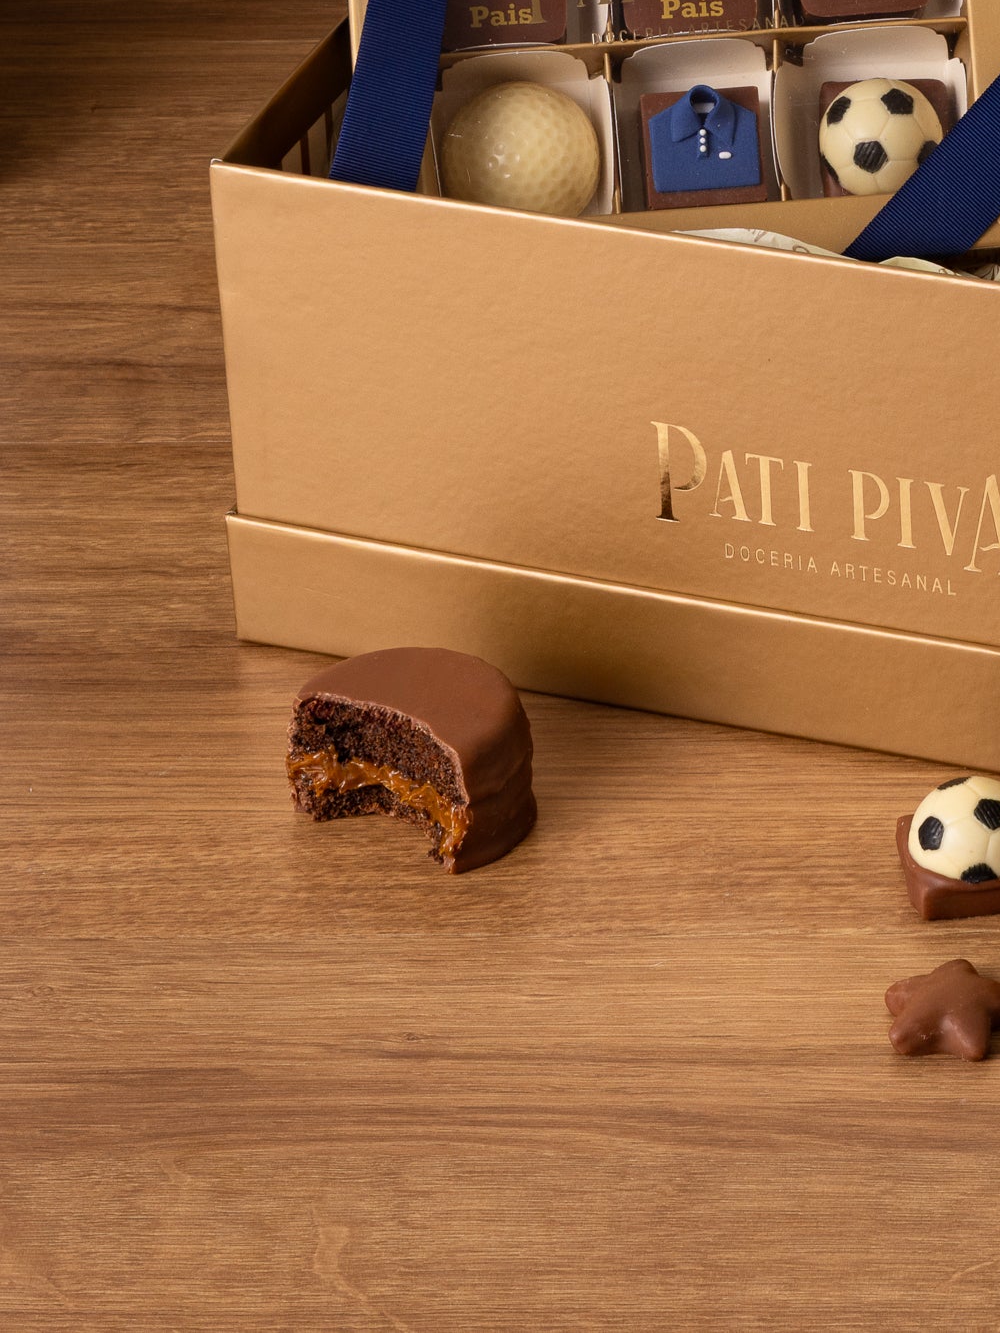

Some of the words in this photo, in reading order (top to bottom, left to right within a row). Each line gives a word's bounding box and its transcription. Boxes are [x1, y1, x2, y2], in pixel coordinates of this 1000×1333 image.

[469, 3, 534, 28] Pais
[650, 421, 815, 533] PATI
[724, 542, 819, 574] DOCERIA
[830, 560, 957, 596] ARTESANAL
